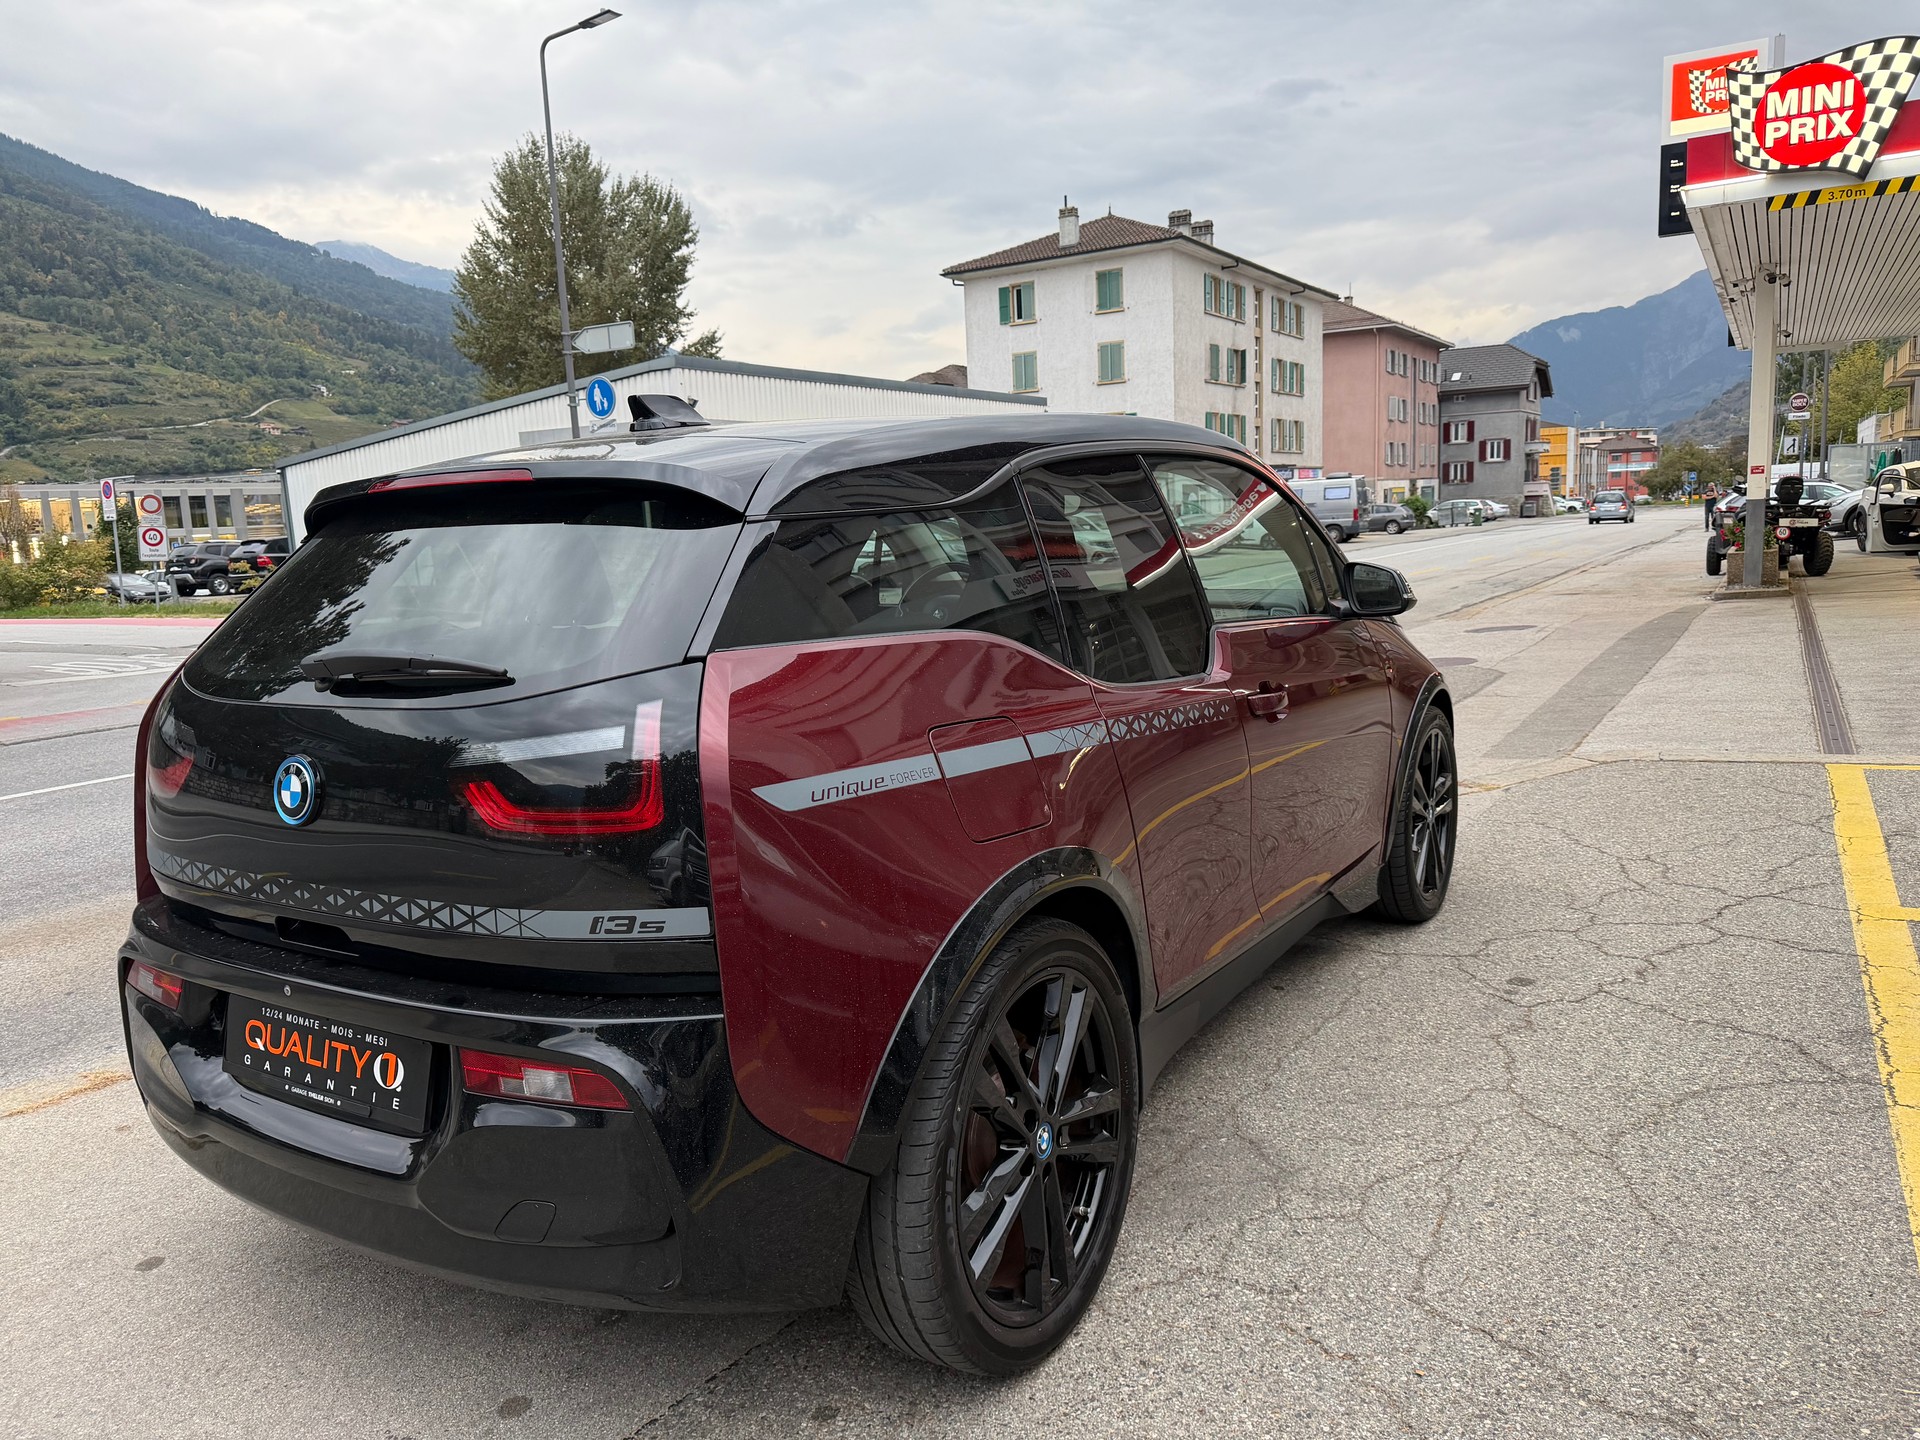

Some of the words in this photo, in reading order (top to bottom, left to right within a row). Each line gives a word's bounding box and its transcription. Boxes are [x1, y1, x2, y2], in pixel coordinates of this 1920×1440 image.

[1705, 76, 1728, 91] MI
[1766, 79, 1855, 120] MINI
[1764, 109, 1854, 149] PRIX
[148, 533, 158, 541] 40
[1779, 528, 1787, 536] 60
[811, 776, 889, 803] unique
[889, 767, 936, 786] FOREVER
[589, 915, 666, 935] i3s
[261, 1007, 283, 1021] 12/24
[286, 1013, 320, 1030] MONATE
[331, 1024, 354, 1038] MOIS
[365, 1033, 388, 1047] MESI
[245, 1019, 372, 1079] QUALITY
[244, 1054, 401, 1110] GARANTIE
